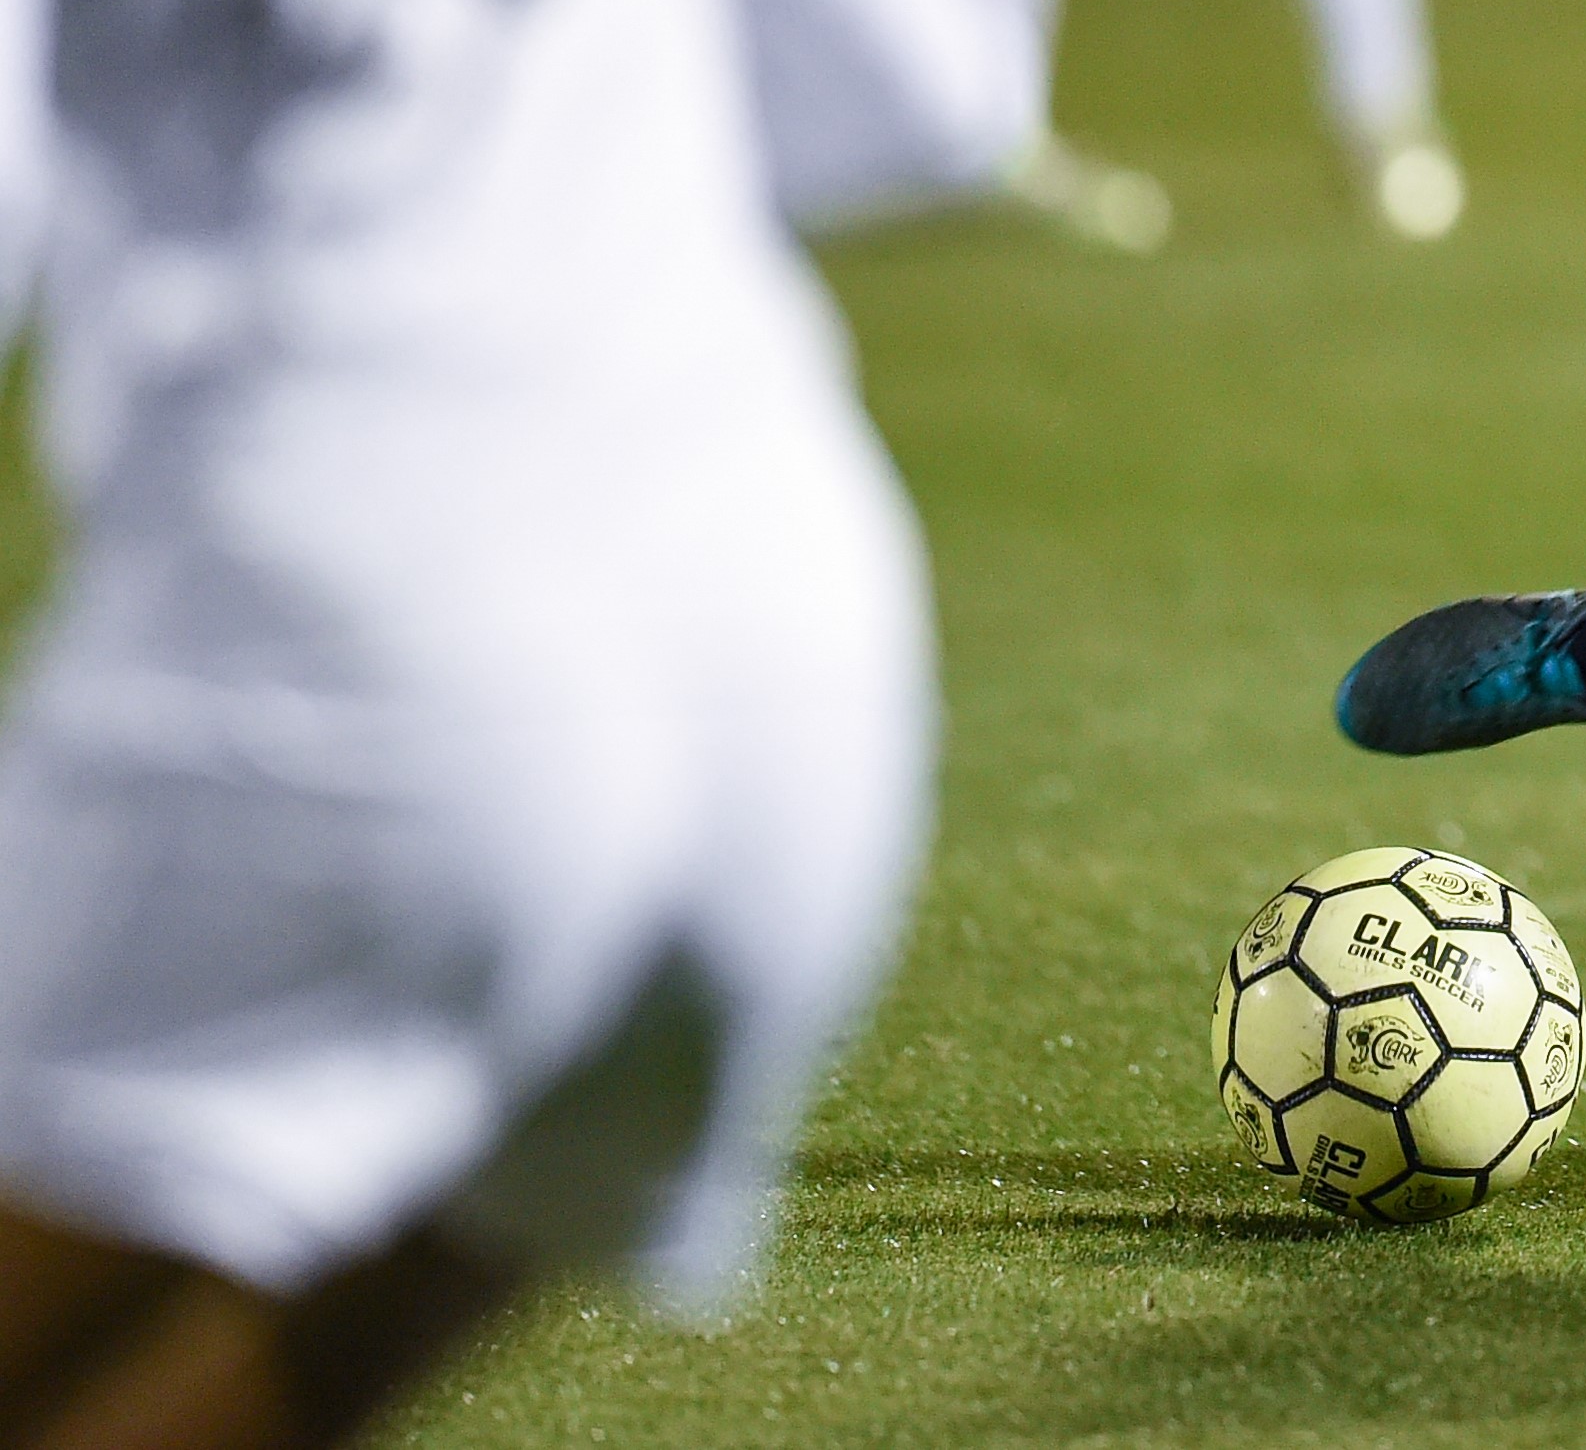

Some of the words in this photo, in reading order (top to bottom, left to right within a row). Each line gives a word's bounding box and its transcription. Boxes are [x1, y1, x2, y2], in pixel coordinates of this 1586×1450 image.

[1347, 943, 1407, 971] GIRLS
[1409, 964, 1486, 1013] SOCCER
[1306, 1133, 1331, 1175] GIRLS
